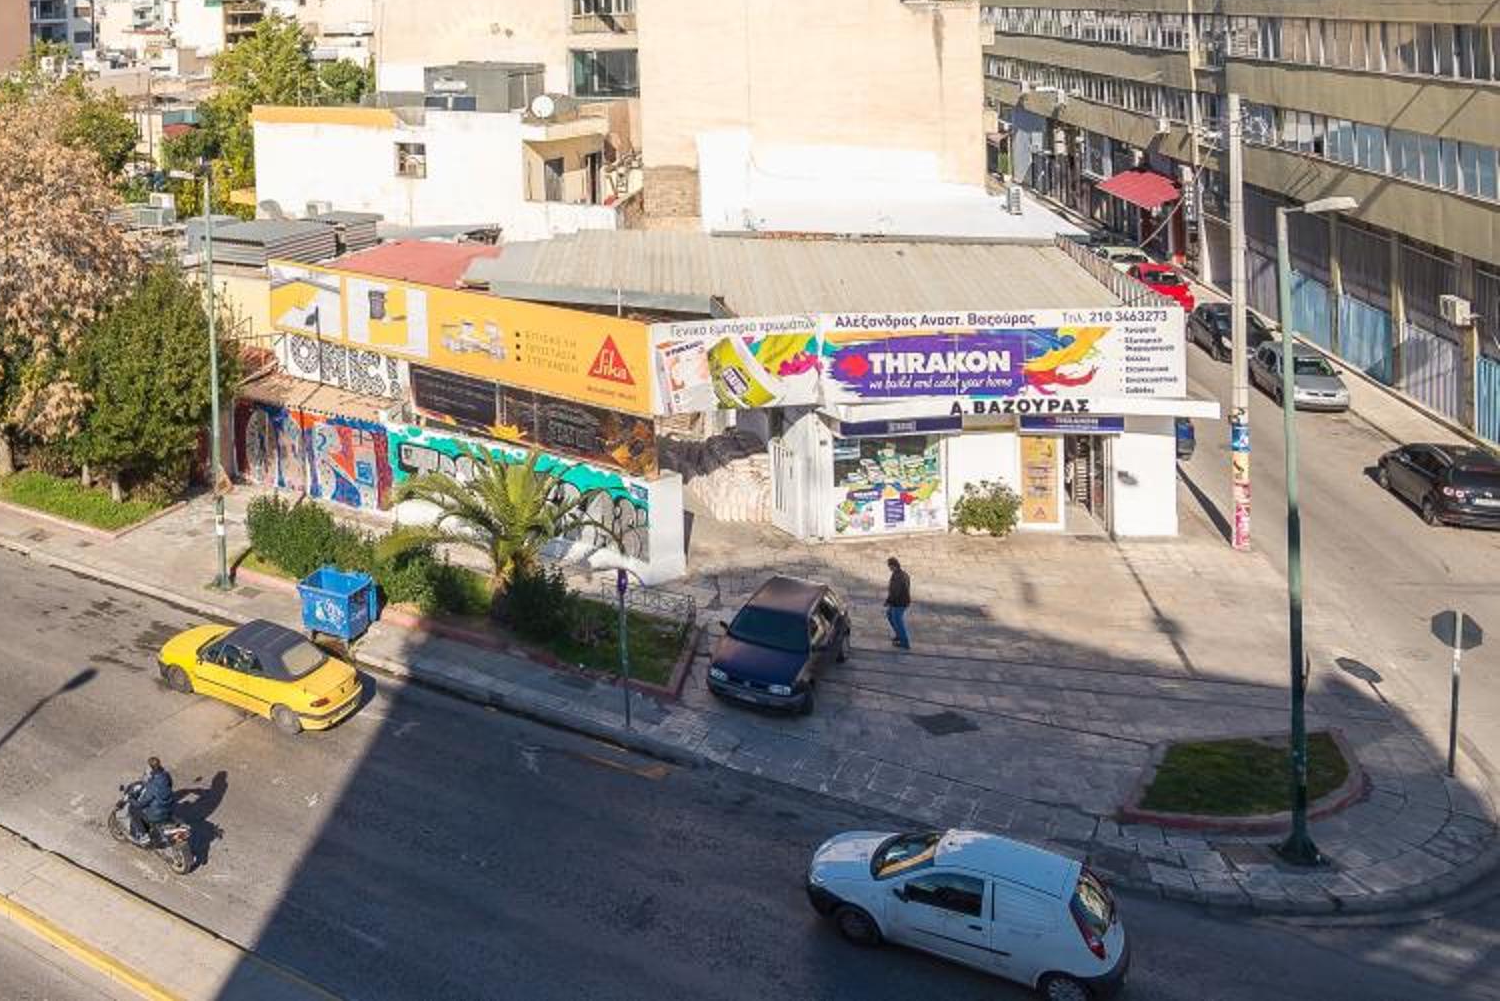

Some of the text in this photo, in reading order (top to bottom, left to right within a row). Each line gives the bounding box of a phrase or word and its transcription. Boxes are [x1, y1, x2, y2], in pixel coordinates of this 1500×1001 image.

[836, 312, 1036, 329] Αλέξανδρος Αναστ. Βαζούρας
[1089, 312, 1112, 322] 210
[1115, 310, 1167, 322] 3463273
[593, 349, 628, 380] Sika
[867, 351, 1011, 374] THRAKON
[869, 380, 882, 390] we
[913, 376, 932, 388] and
[961, 379, 983, 393] your
[985, 374, 1012, 388] home
[950, 399, 1089, 415] Α. ΒΑΖΟΥΡΑΣ
